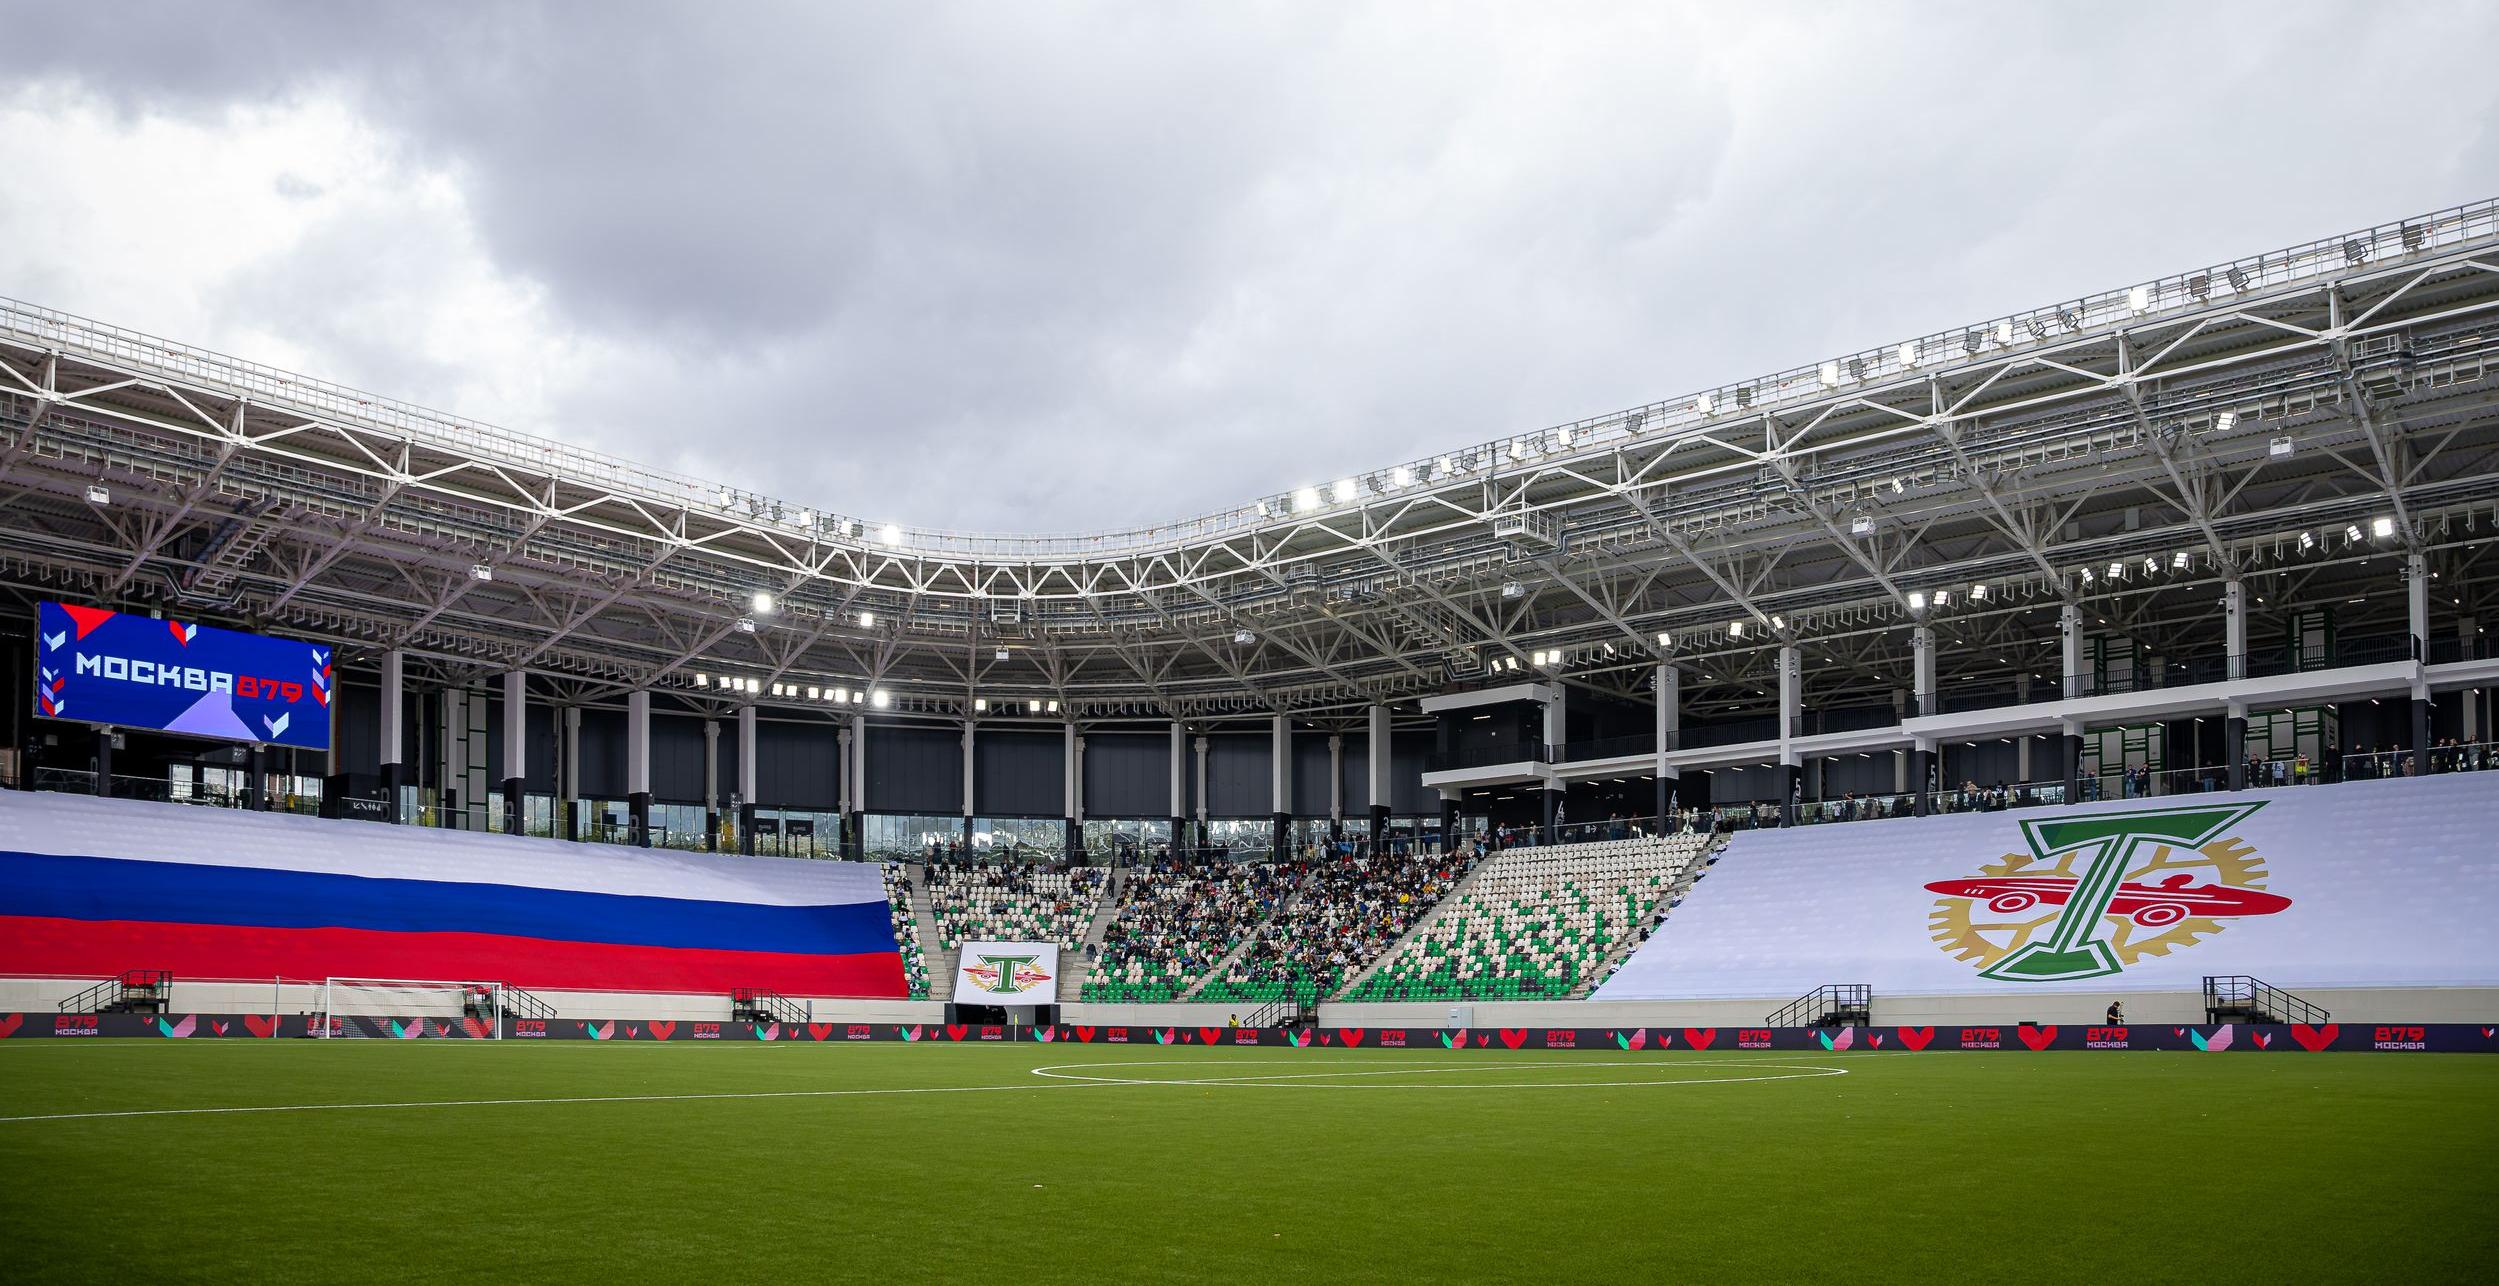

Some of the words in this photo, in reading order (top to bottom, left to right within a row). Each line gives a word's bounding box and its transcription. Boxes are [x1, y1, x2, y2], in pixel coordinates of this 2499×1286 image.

[55, 1015, 99, 1027] 879
[515, 1020, 546, 1031] 879
[694, 1023, 720, 1033] 879
[847, 1025, 870, 1034] 879
[1235, 1029, 1258, 1038] 879
[1381, 1030, 1406, 1040] 879
[1547, 1030, 1575, 1040] 879
[1738, 1029, 1772, 1041] 879
[1961, 1029, 1999, 1041] 879
[2086, 1028, 2128, 1040] 879
[2375, 1027, 2425, 1041] 879
[2375, 1041, 2425, 1049] МОСКВА
